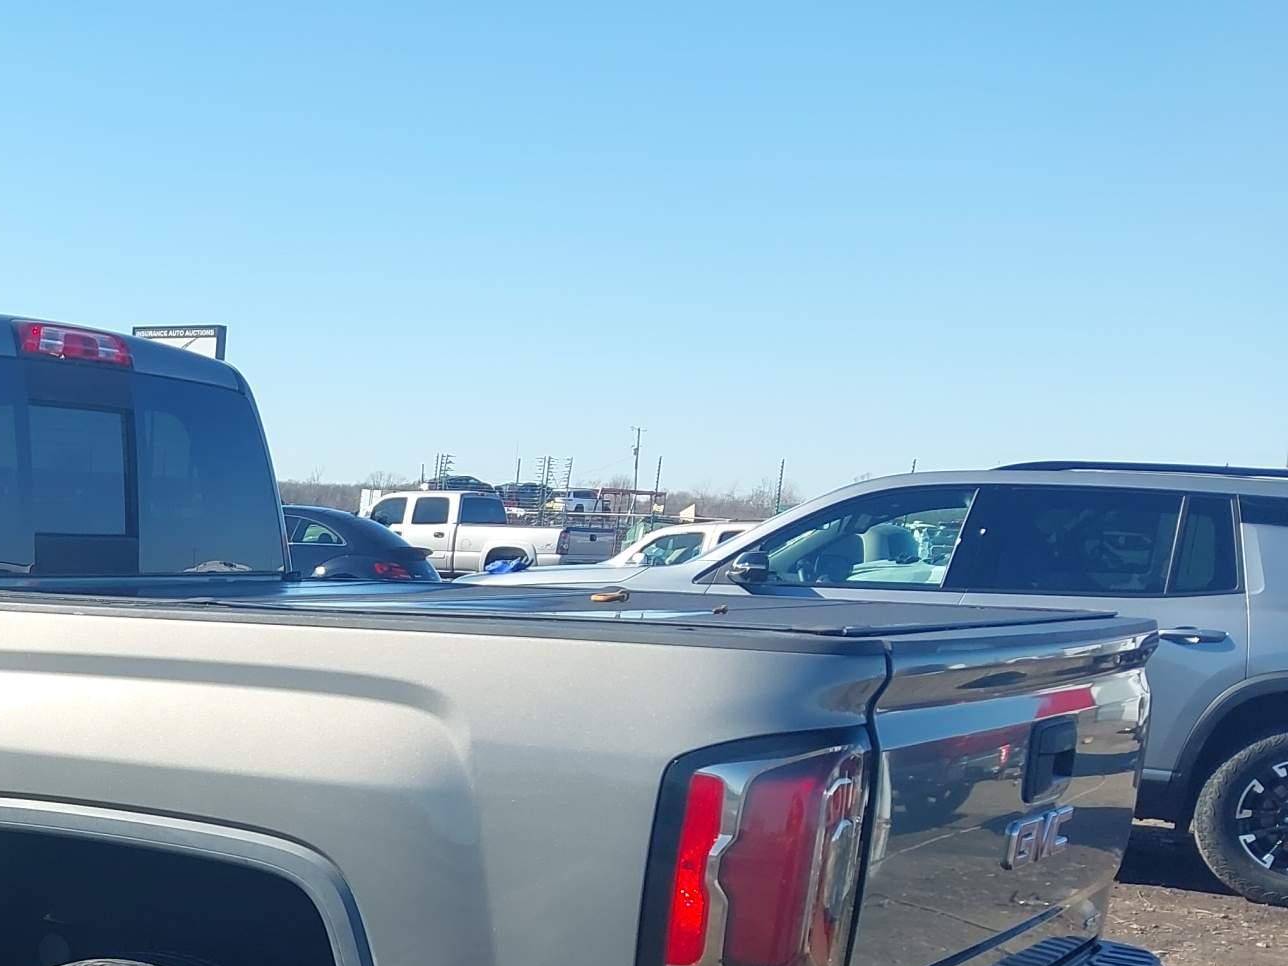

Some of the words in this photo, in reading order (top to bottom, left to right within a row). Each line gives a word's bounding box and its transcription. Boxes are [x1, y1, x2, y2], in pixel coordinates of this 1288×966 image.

[135, 329, 168, 338] INSURANCE
[168, 329, 184, 337] AUTO
[184, 329, 215, 337] AUCTIONS
[1002, 805, 1074, 869] GMC
